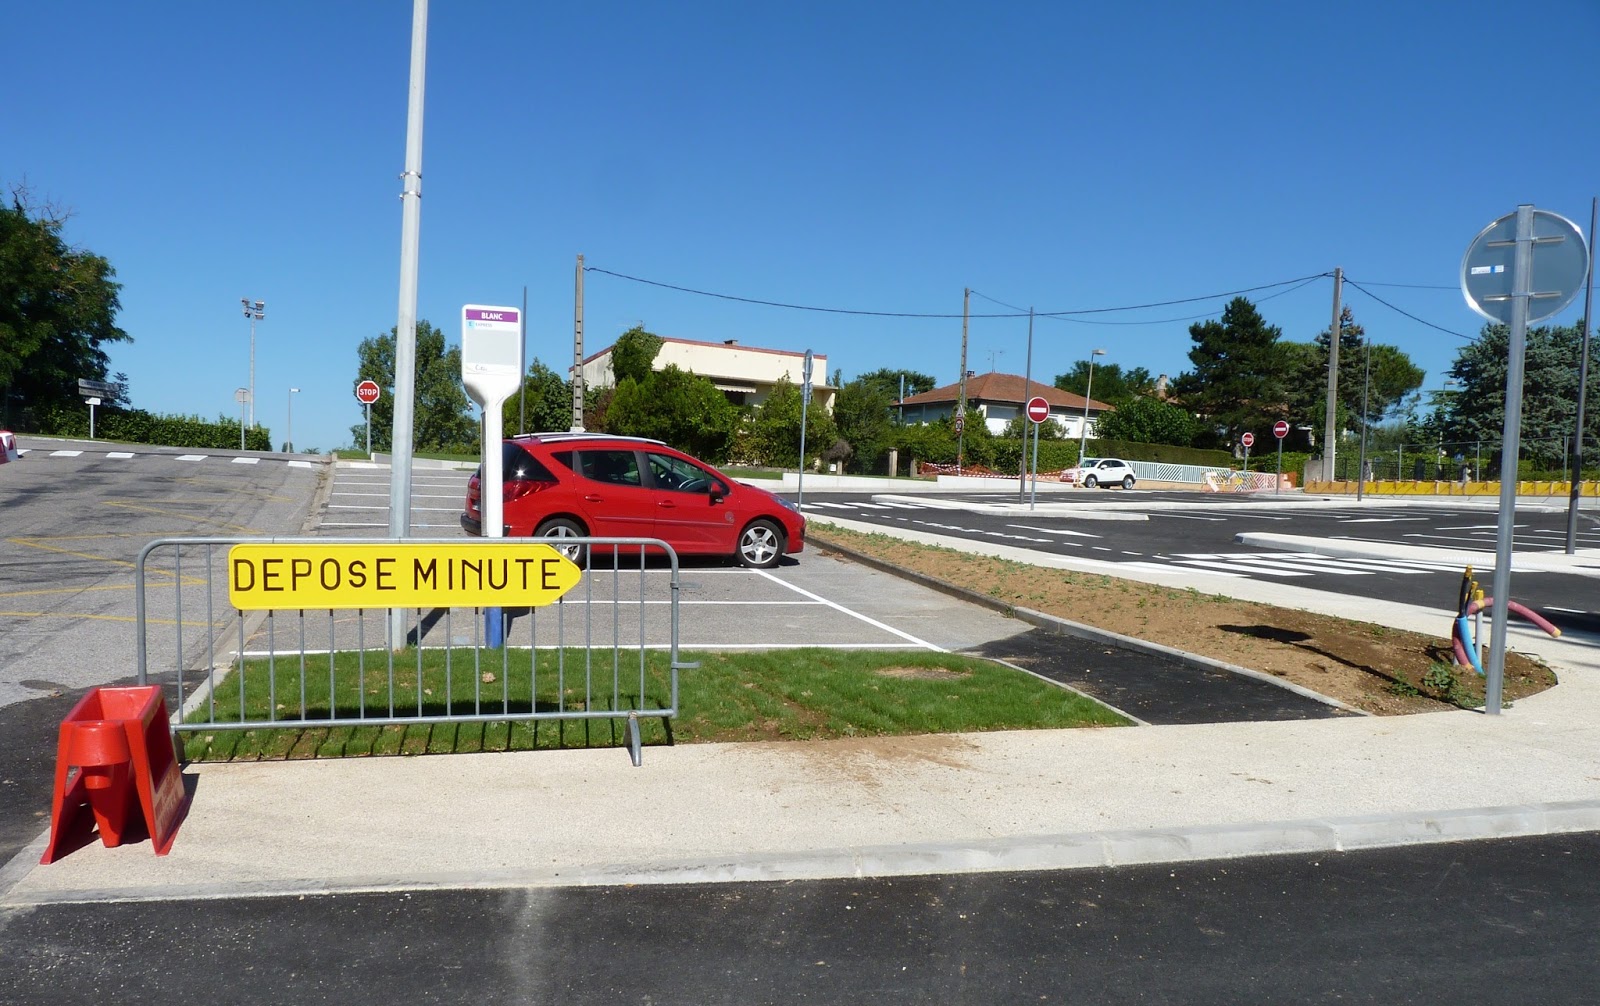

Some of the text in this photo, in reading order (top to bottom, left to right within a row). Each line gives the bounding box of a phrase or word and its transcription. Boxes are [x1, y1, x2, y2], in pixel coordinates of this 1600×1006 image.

[481, 312, 503, 320] BLANC
[359, 388, 377, 396] STOP
[233, 558, 561, 592] DEPOSE MINUTE
